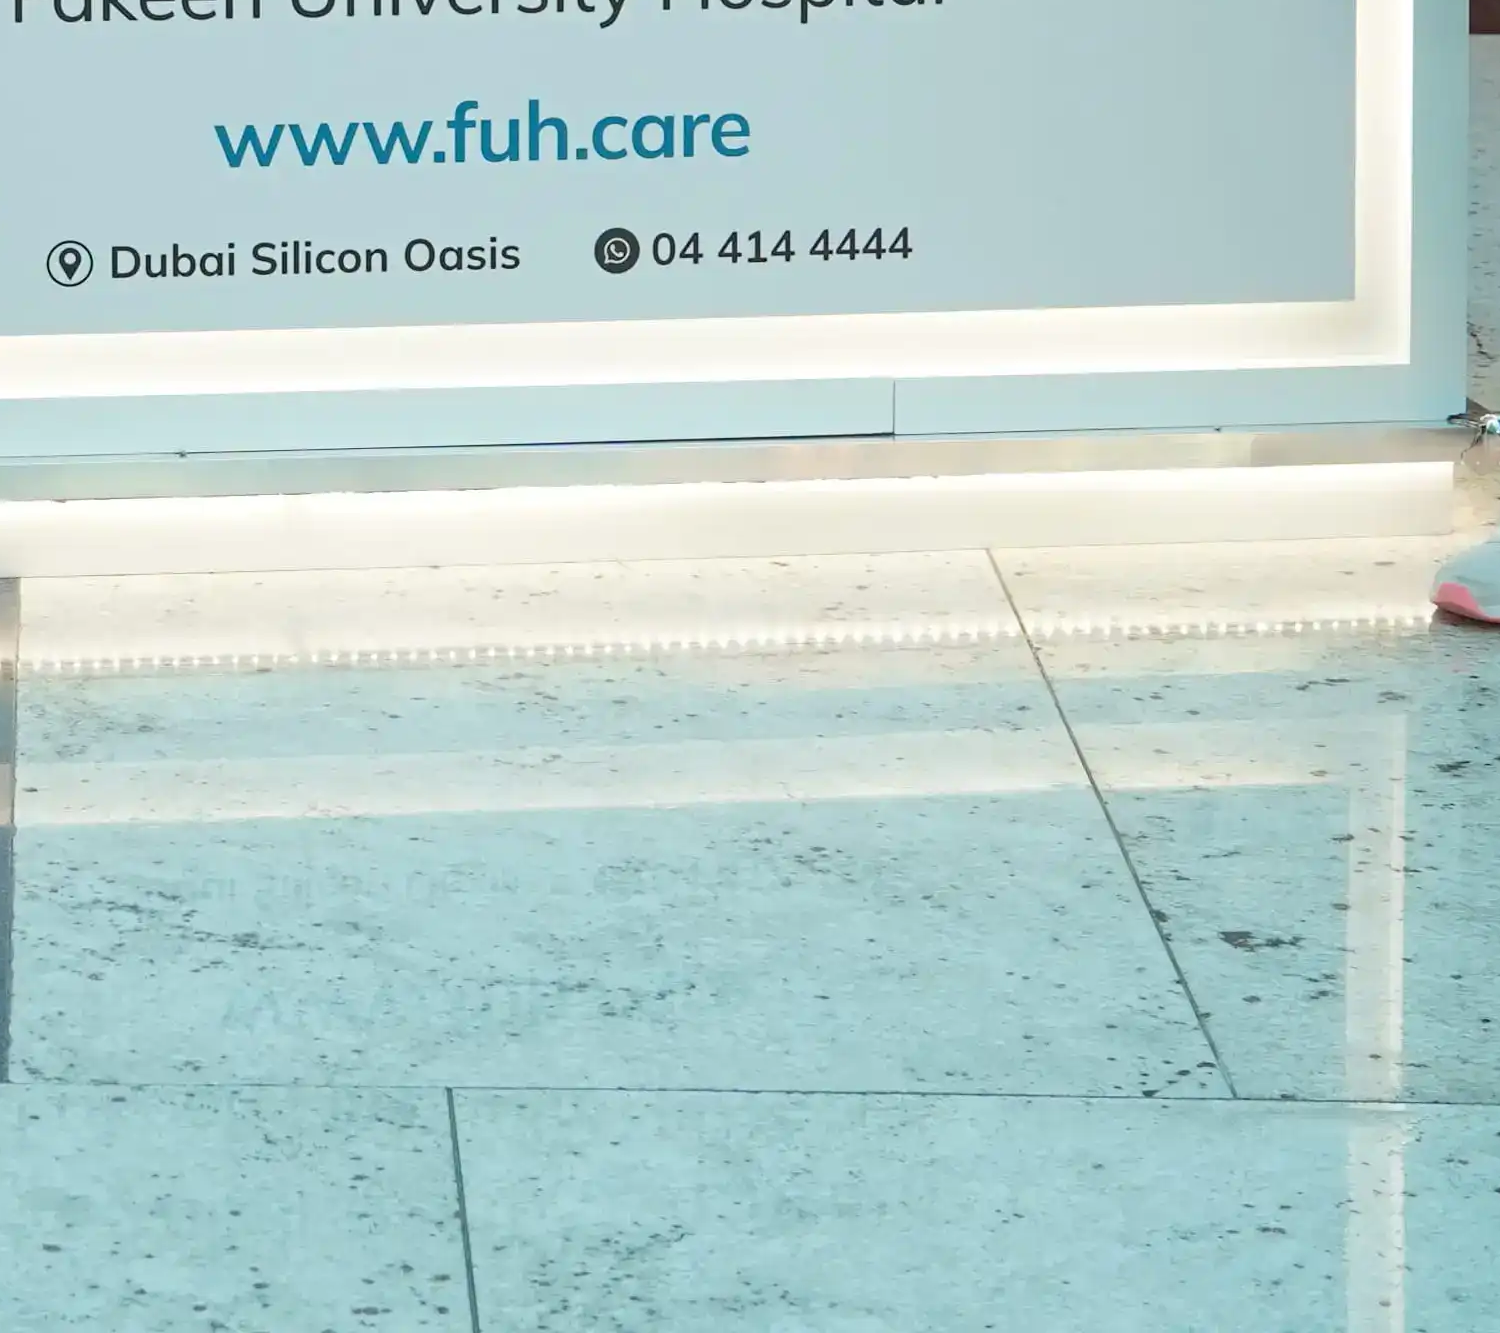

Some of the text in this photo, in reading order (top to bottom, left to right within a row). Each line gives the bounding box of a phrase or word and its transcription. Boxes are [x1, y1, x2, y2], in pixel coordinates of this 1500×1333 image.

[213, 99, 751, 168] www.fuh.care
[111, 236, 521, 279] Dubai Silicon Oasis
[652, 226, 914, 267] 04 414 4444
